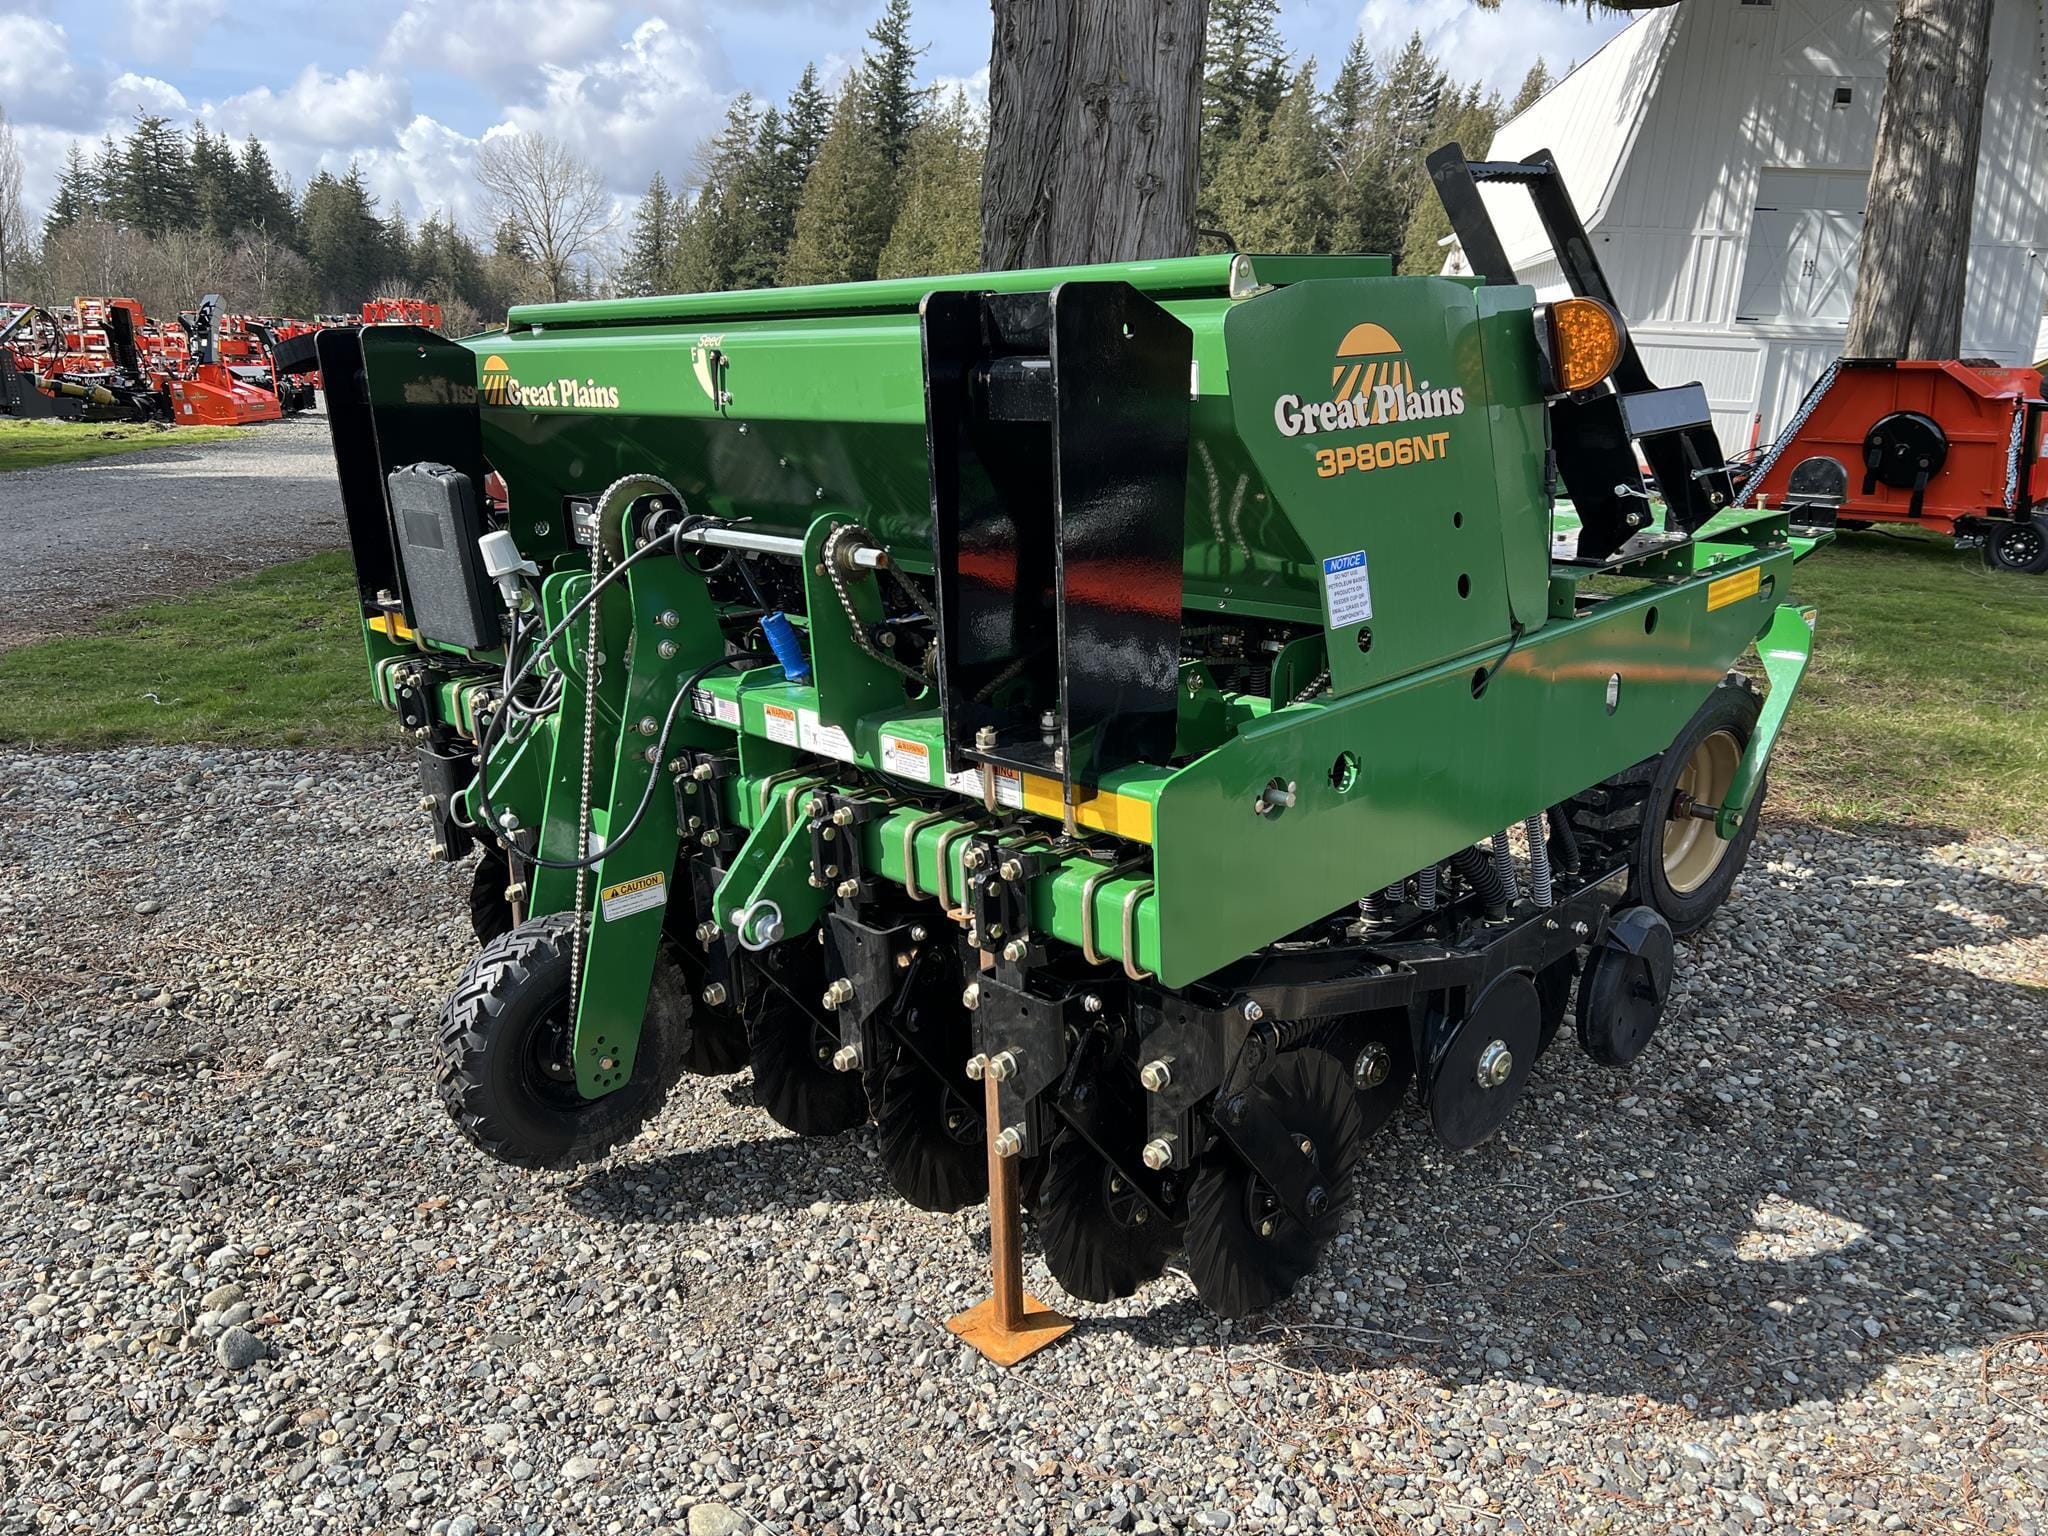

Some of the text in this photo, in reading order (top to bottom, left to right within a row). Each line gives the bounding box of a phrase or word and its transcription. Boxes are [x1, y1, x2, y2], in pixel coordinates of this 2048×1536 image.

[698, 334, 725, 347] Seed
[691, 347, 697, 362] F
[507, 378, 558, 407] Great
[557, 379, 620, 408] Plains
[1274, 380, 1465, 437] Great Plains
[1315, 431, 1450, 479] 3P806NT
[1330, 555, 1361, 571] NOTICE
[620, 876, 658, 894] CAUTION
